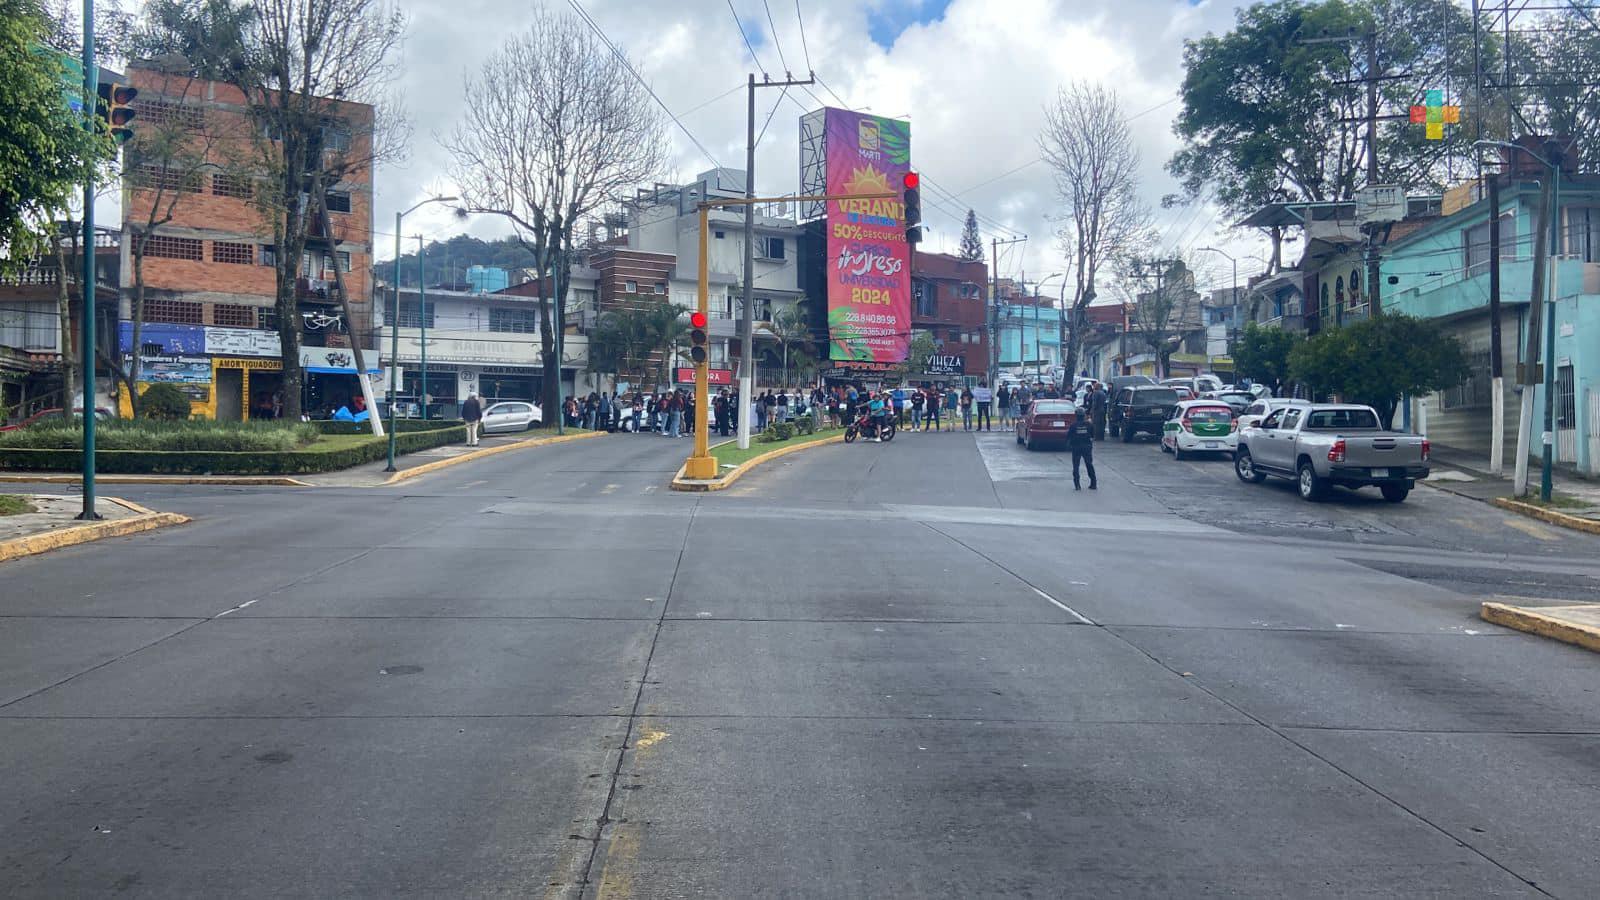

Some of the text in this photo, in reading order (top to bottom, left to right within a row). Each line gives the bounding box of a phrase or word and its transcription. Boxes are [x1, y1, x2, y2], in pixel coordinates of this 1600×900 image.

[833, 223, 906, 242] 50% DESCUENTO
[851, 287, 891, 305] 2024
